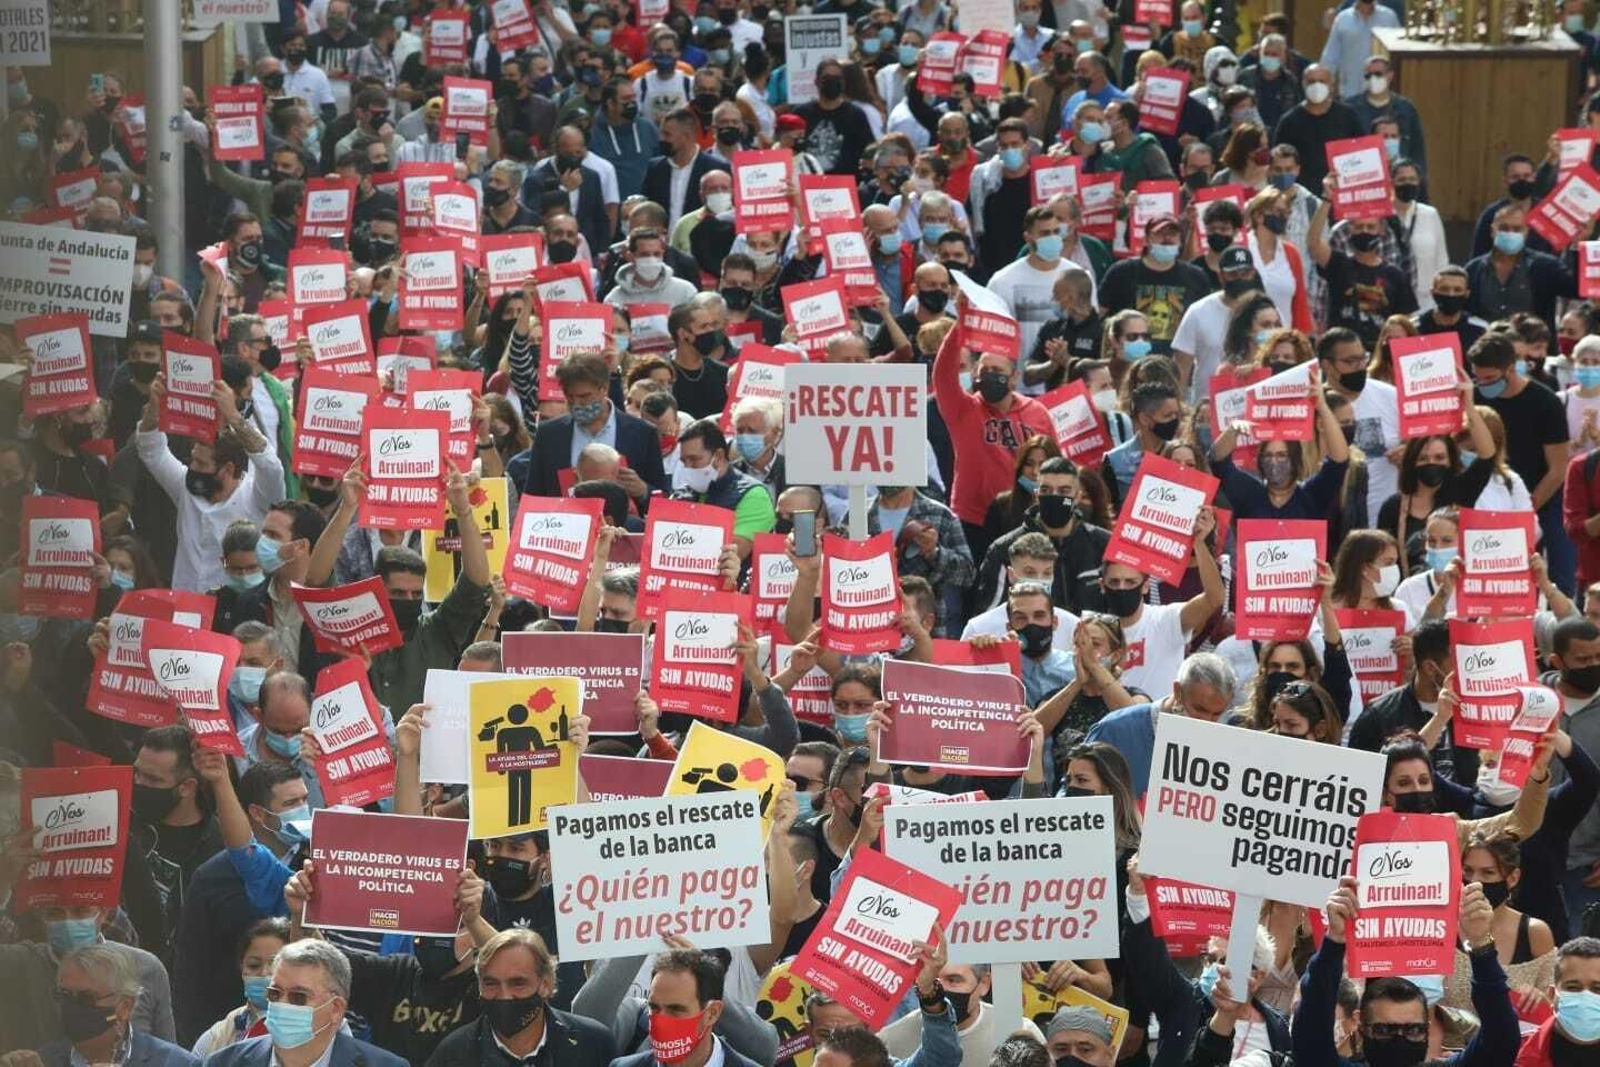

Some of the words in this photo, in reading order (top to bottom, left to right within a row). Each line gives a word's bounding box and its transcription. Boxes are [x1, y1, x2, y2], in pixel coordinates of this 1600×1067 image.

[8, 31, 46, 53] 2021
[37, 236, 54, 251] de
[57, 240, 130, 260] Andalucía
[39, 300, 62, 314] sin
[405, 295, 421, 307] SIN
[422, 295, 458, 308] AYUDAS
[29, 380, 47, 396] SIN
[49, 377, 89, 393] AYUDAS
[314, 393, 343, 411] Nos
[789, 385, 918, 424] ¡RESCATE
[310, 414, 361, 432] Arruinan!
[298, 433, 316, 449] SIN
[317, 436, 360, 459] AYUDAS
[379, 434, 413, 455] Nos
[824, 425, 895, 473] YA!
[378, 459, 435, 475] Arruinan!
[367, 484, 388, 501] SIN
[390, 486, 439, 503] AYUDAS
[1146, 487, 1178, 502] Nos
[531, 516, 563, 531] Nos
[1138, 504, 1193, 532] Arruinan!
[38, 524, 71, 544] Nos
[528, 534, 582, 555] Arruinan!
[662, 529, 696, 548] Nos
[1121, 522, 1141, 540] SIN
[1142, 531, 1188, 560] AYUDAS
[35, 549, 91, 563] Arruinan!
[658, 553, 719, 571] Arruinan!
[1255, 544, 1289, 567] Nos
[1472, 553, 1523, 571] Arruinan!
[513, 553, 534, 571] SIN
[535, 557, 580, 586] AYUDAS
[838, 566, 870, 584] Nos
[1255, 569, 1312, 587] Arruinan!
[23, 573, 43, 588] SIN
[44, 576, 92, 592] AYUDAS
[1463, 579, 1483, 593] SIN
[1485, 579, 1529, 594] AYUDAS
[836, 584, 891, 604] Arruinan!
[317, 602, 348, 619] Nos
[756, 603, 774, 618] SIN
[1244, 596, 1266, 613] SIN
[1268, 596, 1316, 614] AYUDAS
[675, 619, 710, 640] Nos
[828, 608, 847, 626] SIN
[849, 610, 896, 630] AYUDAS
[116, 621, 141, 641] Nos
[340, 622, 390, 647] AYUDAS
[160, 657, 191, 680] Nos
[506, 667, 520, 676] EL
[521, 667, 587, 677] VERDADERO
[590, 667, 622, 677] VIRUS
[625, 667, 639, 677] ES
[1464, 653, 1497, 673] Nos
[100, 670, 123, 690] SIN
[660, 668, 682, 685] SIN
[684, 670, 734, 693] AYUDAS
[887, 691, 900, 701] EL
[903, 692, 974, 708] VERDADERO
[977, 701, 1012, 712] VIRUS
[1460, 702, 1478, 720] SIN
[316, 700, 342, 728] Nos
[899, 703, 915, 715] LA
[917, 706, 1015, 722] INCOMPETENCIA
[323, 717, 374, 748] Arruinan!
[931, 717, 986, 732] POLÍTICA
[326, 760, 350, 781] SIN
[351, 745, 391, 775] AYUDAS
[1162, 742, 1231, 792] Nos
[1241, 767, 1368, 818] cerráis
[45, 801, 85, 829] Nos
[555, 810, 651, 840] Pagamos
[656, 804, 675, 826] el
[679, 800, 755, 824] rescate
[1158, 786, 1217, 823] PERO
[1222, 802, 1357, 850] seguimos
[42, 825, 111, 850] Arruinan!
[896, 818, 995, 844] Pagamos
[1000, 812, 1018, 833] el
[1025, 811, 1106, 833] rescate
[600, 838, 625, 860] de
[630, 835, 649, 857] la
[654, 832, 717, 854] banca
[940, 842, 967, 864] de
[972, 840, 991, 862] la
[997, 840, 1063, 861] banca
[28, 861, 50, 880] SIN
[54, 857, 114, 876] AYUDAS
[312, 849, 326, 859] EL
[329, 850, 403, 865] VERDADERO
[406, 855, 441, 868] VIRUS
[444, 858, 460, 869] ES
[1370, 851, 1414, 877] Nos
[325, 864, 341, 874] LA
[344, 865, 444, 882] INCOMPETENCIA
[358, 877, 415, 894] POLÍTICA
[558, 867, 670, 914] ¿Quién
[679, 864, 760, 905] paga
[1021, 875, 1107, 911] paga
[1366, 883, 1442, 903] Arruinan!
[857, 893, 901, 919] Nos
[1156, 886, 1180, 903] SIN
[1181, 887, 1231, 908] AYUDAS
[576, 911, 604, 944] el
[614, 898, 754, 941] nuestro?
[950, 908, 1099, 944] nuestro?
[1355, 918, 1380, 938] SIN
[1383, 917, 1447, 938] AYUDAS
[843, 916, 917, 958] Arruinan!
[817, 936, 848, 960] SIN
[844, 949, 904, 995] AYUDAS
